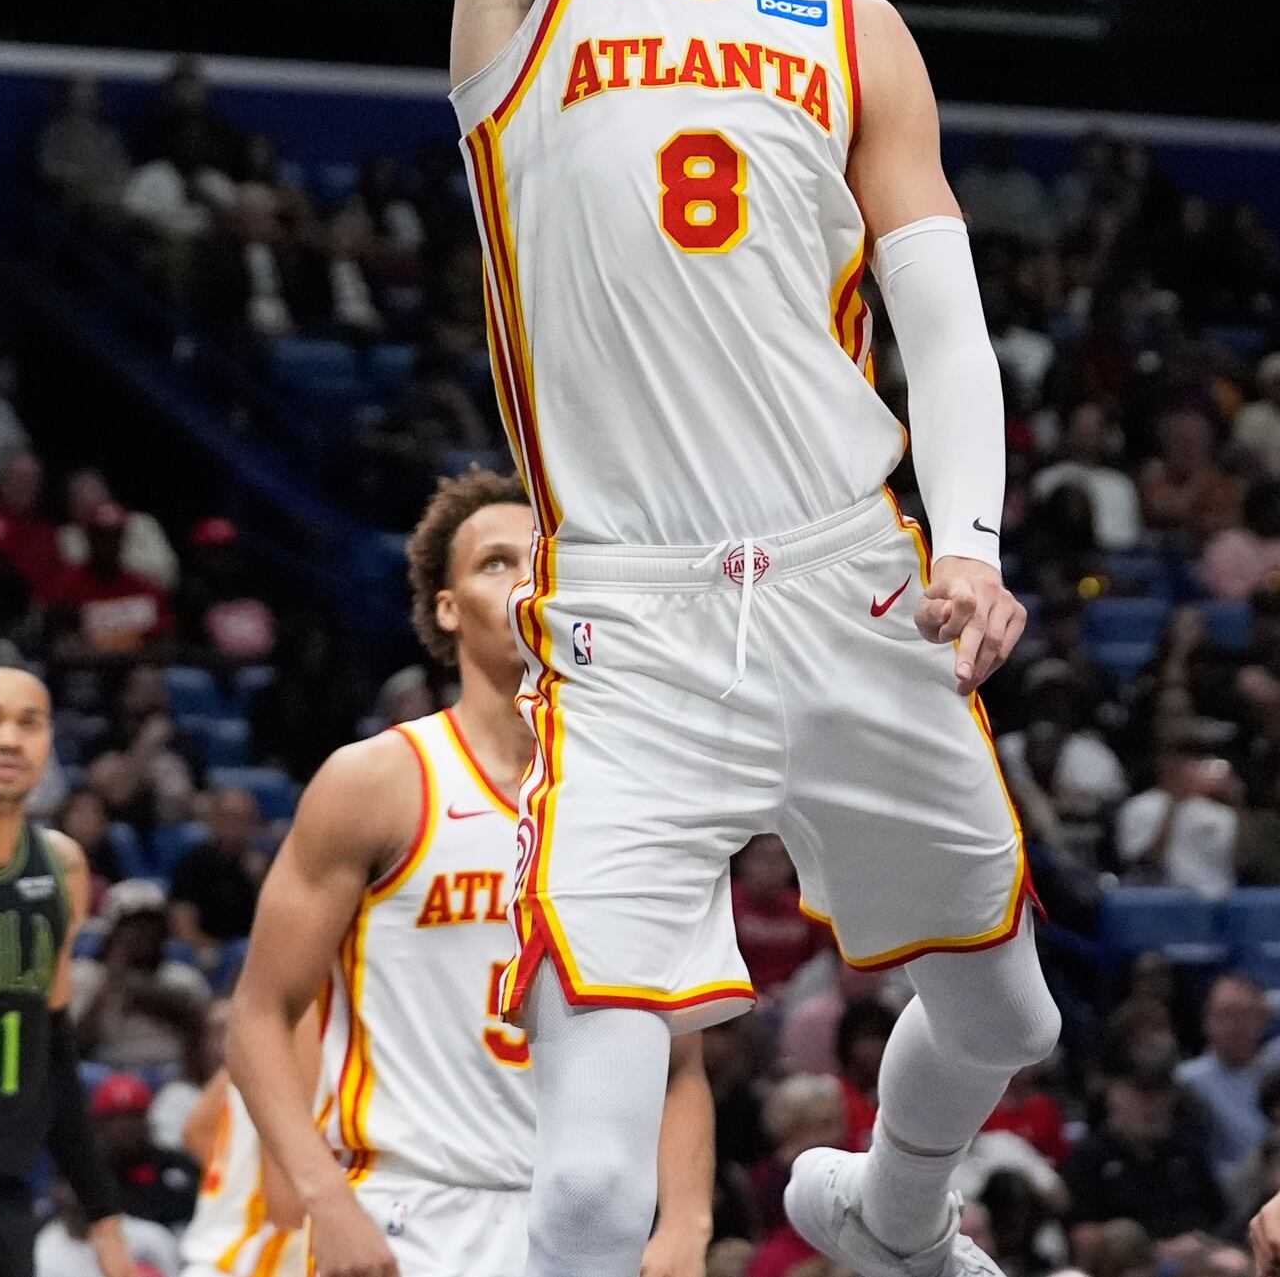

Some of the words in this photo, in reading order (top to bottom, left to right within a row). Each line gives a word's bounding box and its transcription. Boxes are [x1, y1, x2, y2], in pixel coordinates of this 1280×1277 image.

[561, 37, 833, 135] ATLANTA
[656, 129, 748, 254] 8
[723, 555, 770, 575] HAKS
